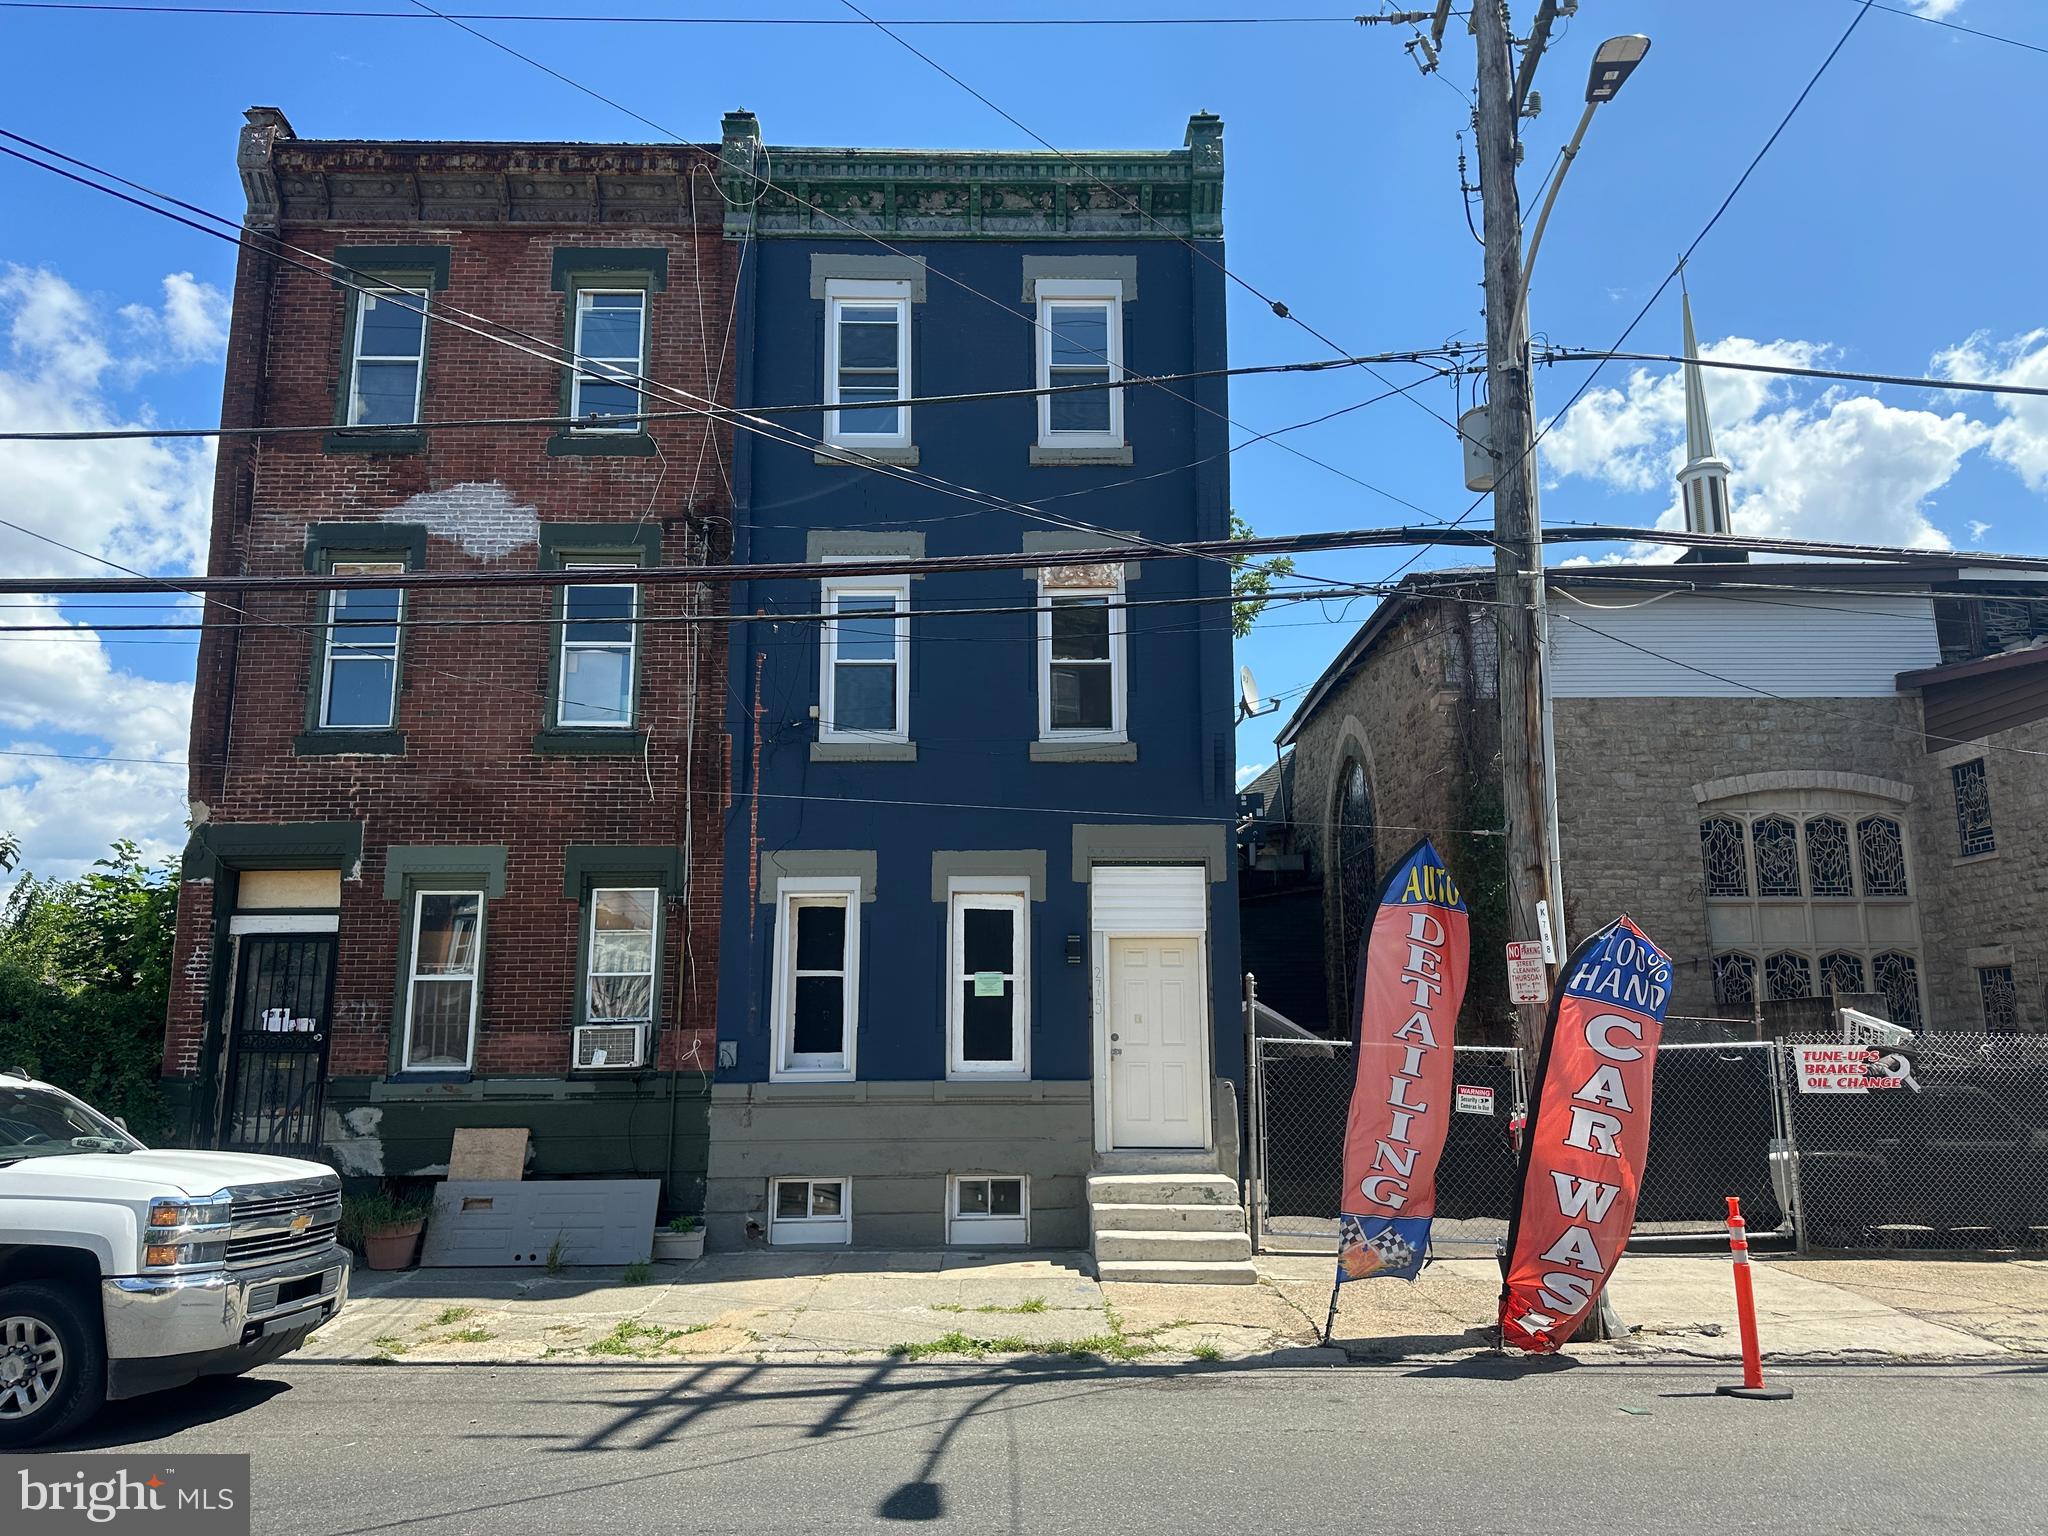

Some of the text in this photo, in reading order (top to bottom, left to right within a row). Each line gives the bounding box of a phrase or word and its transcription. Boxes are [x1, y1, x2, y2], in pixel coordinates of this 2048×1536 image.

[1508, 945, 1520, 959] NO
[1599, 932, 1669, 983] 100%
[1512, 974, 1542, 982] THURSDAY
[1094, 966, 1103, 1015] 2715
[1570, 962, 1666, 1012] HAND
[1360, 911, 1446, 1210] DETAILING
[1802, 1050, 1880, 1063] TUNE-UPS
[1804, 1063, 1868, 1075] BRAKES
[1562, 1013, 1644, 1158] CAR
[1807, 1077, 1902, 1089] OIL CHANGE
[1461, 1088, 1491, 1097] WARNING
[1461, 1096, 1477, 1104] Security
